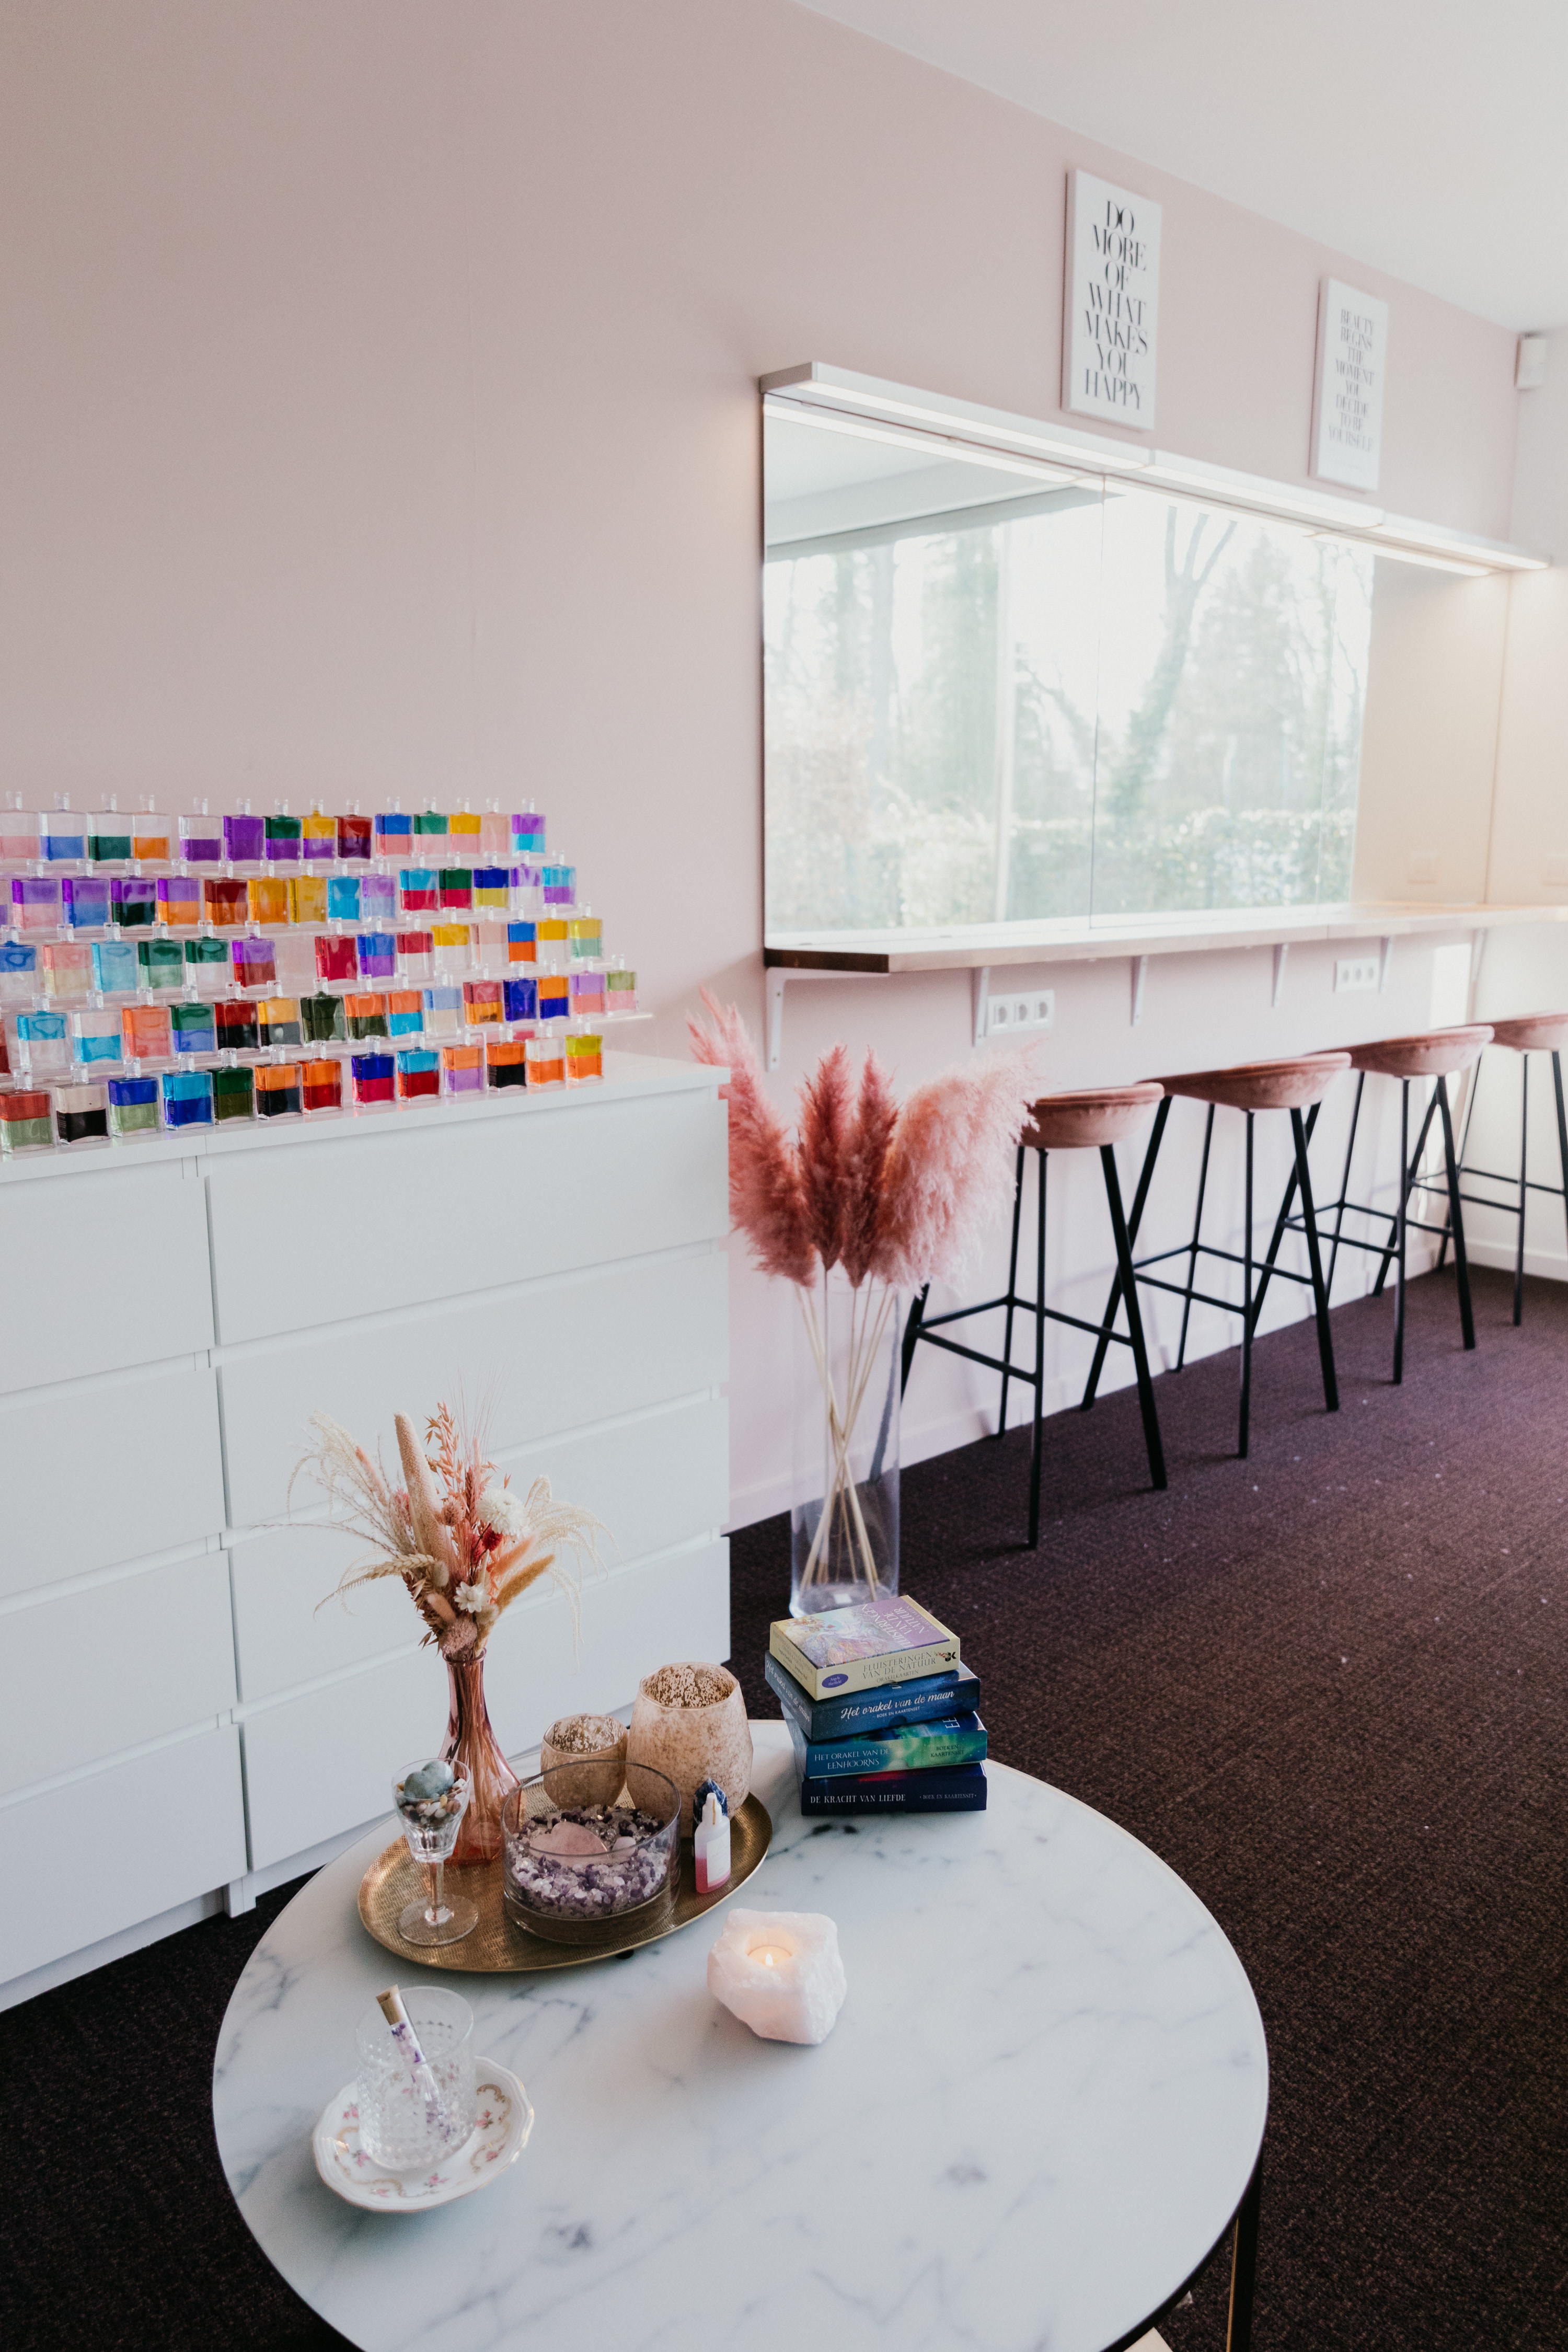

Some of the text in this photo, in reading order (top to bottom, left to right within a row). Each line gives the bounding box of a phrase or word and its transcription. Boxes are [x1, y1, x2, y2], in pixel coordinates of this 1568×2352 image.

[1106, 200, 1134, 236] DO
[1091, 224, 1146, 271] MORE
[1105, 261, 1131, 291] OF
[1088, 282, 1146, 326] WHAT
[1084, 310, 1147, 356] MAKES
[1341, 309, 1374, 335] BEAUTY
[1341, 326, 1372, 351] BEGINS
[1097, 343, 1134, 381] YOU
[1346, 343, 1364, 364] THE
[1334, 358, 1375, 386] MOMENT
[1085, 368, 1144, 410] HAPPY
[1345, 380, 1361, 397] YOU
[1336, 394, 1368, 418] DECIDE
[1339, 412, 1364, 432] TO BE
[1329, 424, 1373, 453] YOURSELF
[894, 1607, 927, 1634] NATUUR
[862, 1658, 936, 1679] VAN DE NATUUR
[863, 1652, 932, 1672] FLUISTERINGEN
[840, 1691, 955, 1719] Het orakel van de maan
[895, 1707, 920, 1715] KAARTENSET
[827, 1758, 879, 1769] EENHOORNS
[831, 1751, 861, 1760] ORAKEL
[824, 1795, 857, 1803] KRACHT
